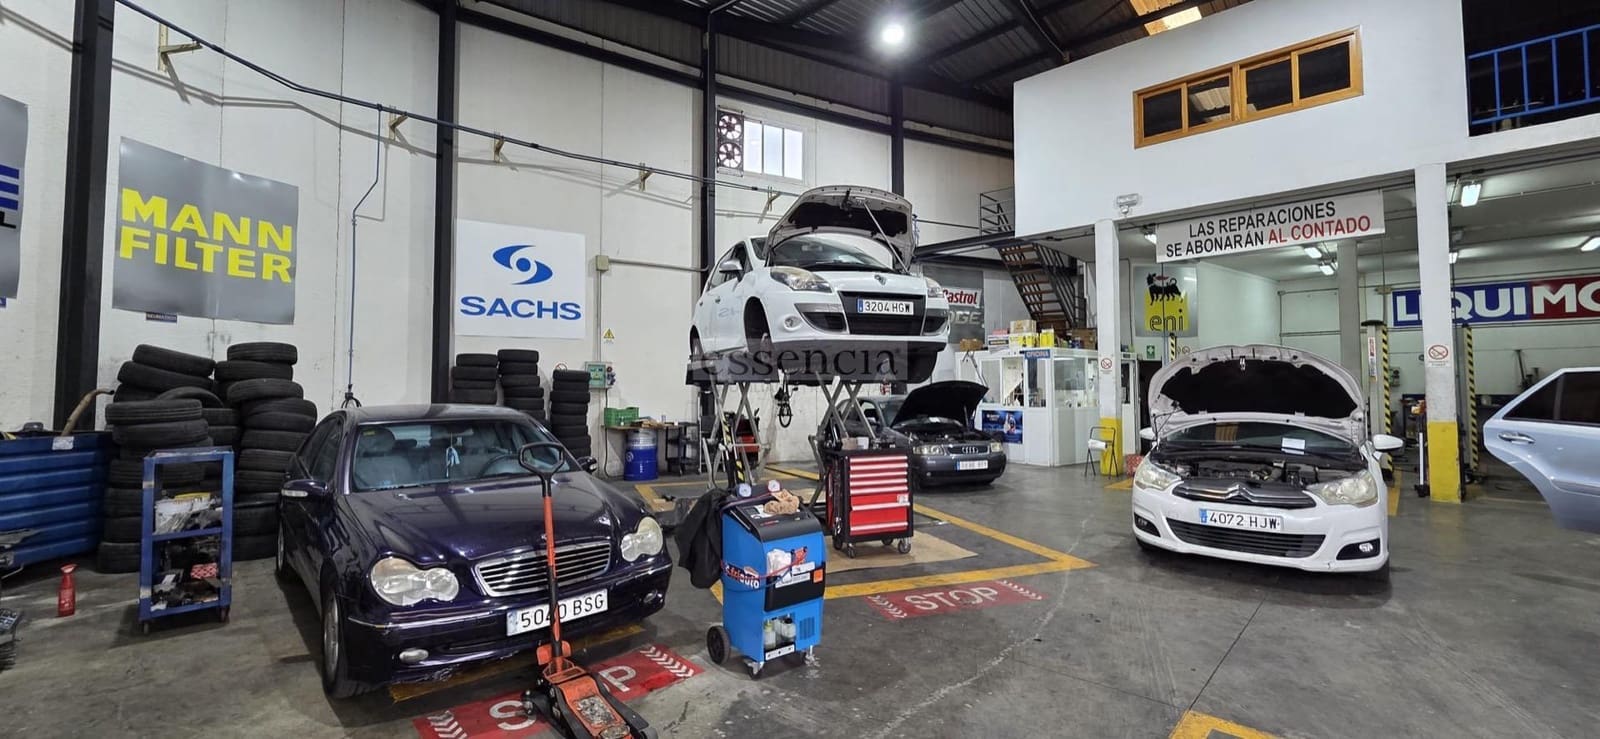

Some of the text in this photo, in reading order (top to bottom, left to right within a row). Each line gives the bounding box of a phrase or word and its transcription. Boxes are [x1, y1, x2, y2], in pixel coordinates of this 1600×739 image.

[121, 188, 293, 252] MANN
[1189, 201, 1336, 238] LAS REPARACIONES
[1166, 215, 1371, 258] SE ABONARÁN AL CONTADO
[119, 225, 292, 283] FILTER
[460, 296, 582, 320] SACHS
[864, 301, 910, 313] 3204 HGW
[1396, 286, 1527, 322] LQUI
[948, 310, 981, 324] DGE
[1150, 309, 1184, 331] eni
[1209, 511, 1278, 529] 4072 HJW
[573, 594, 604, 616] BSG
[905, 586, 999, 611] STOP
